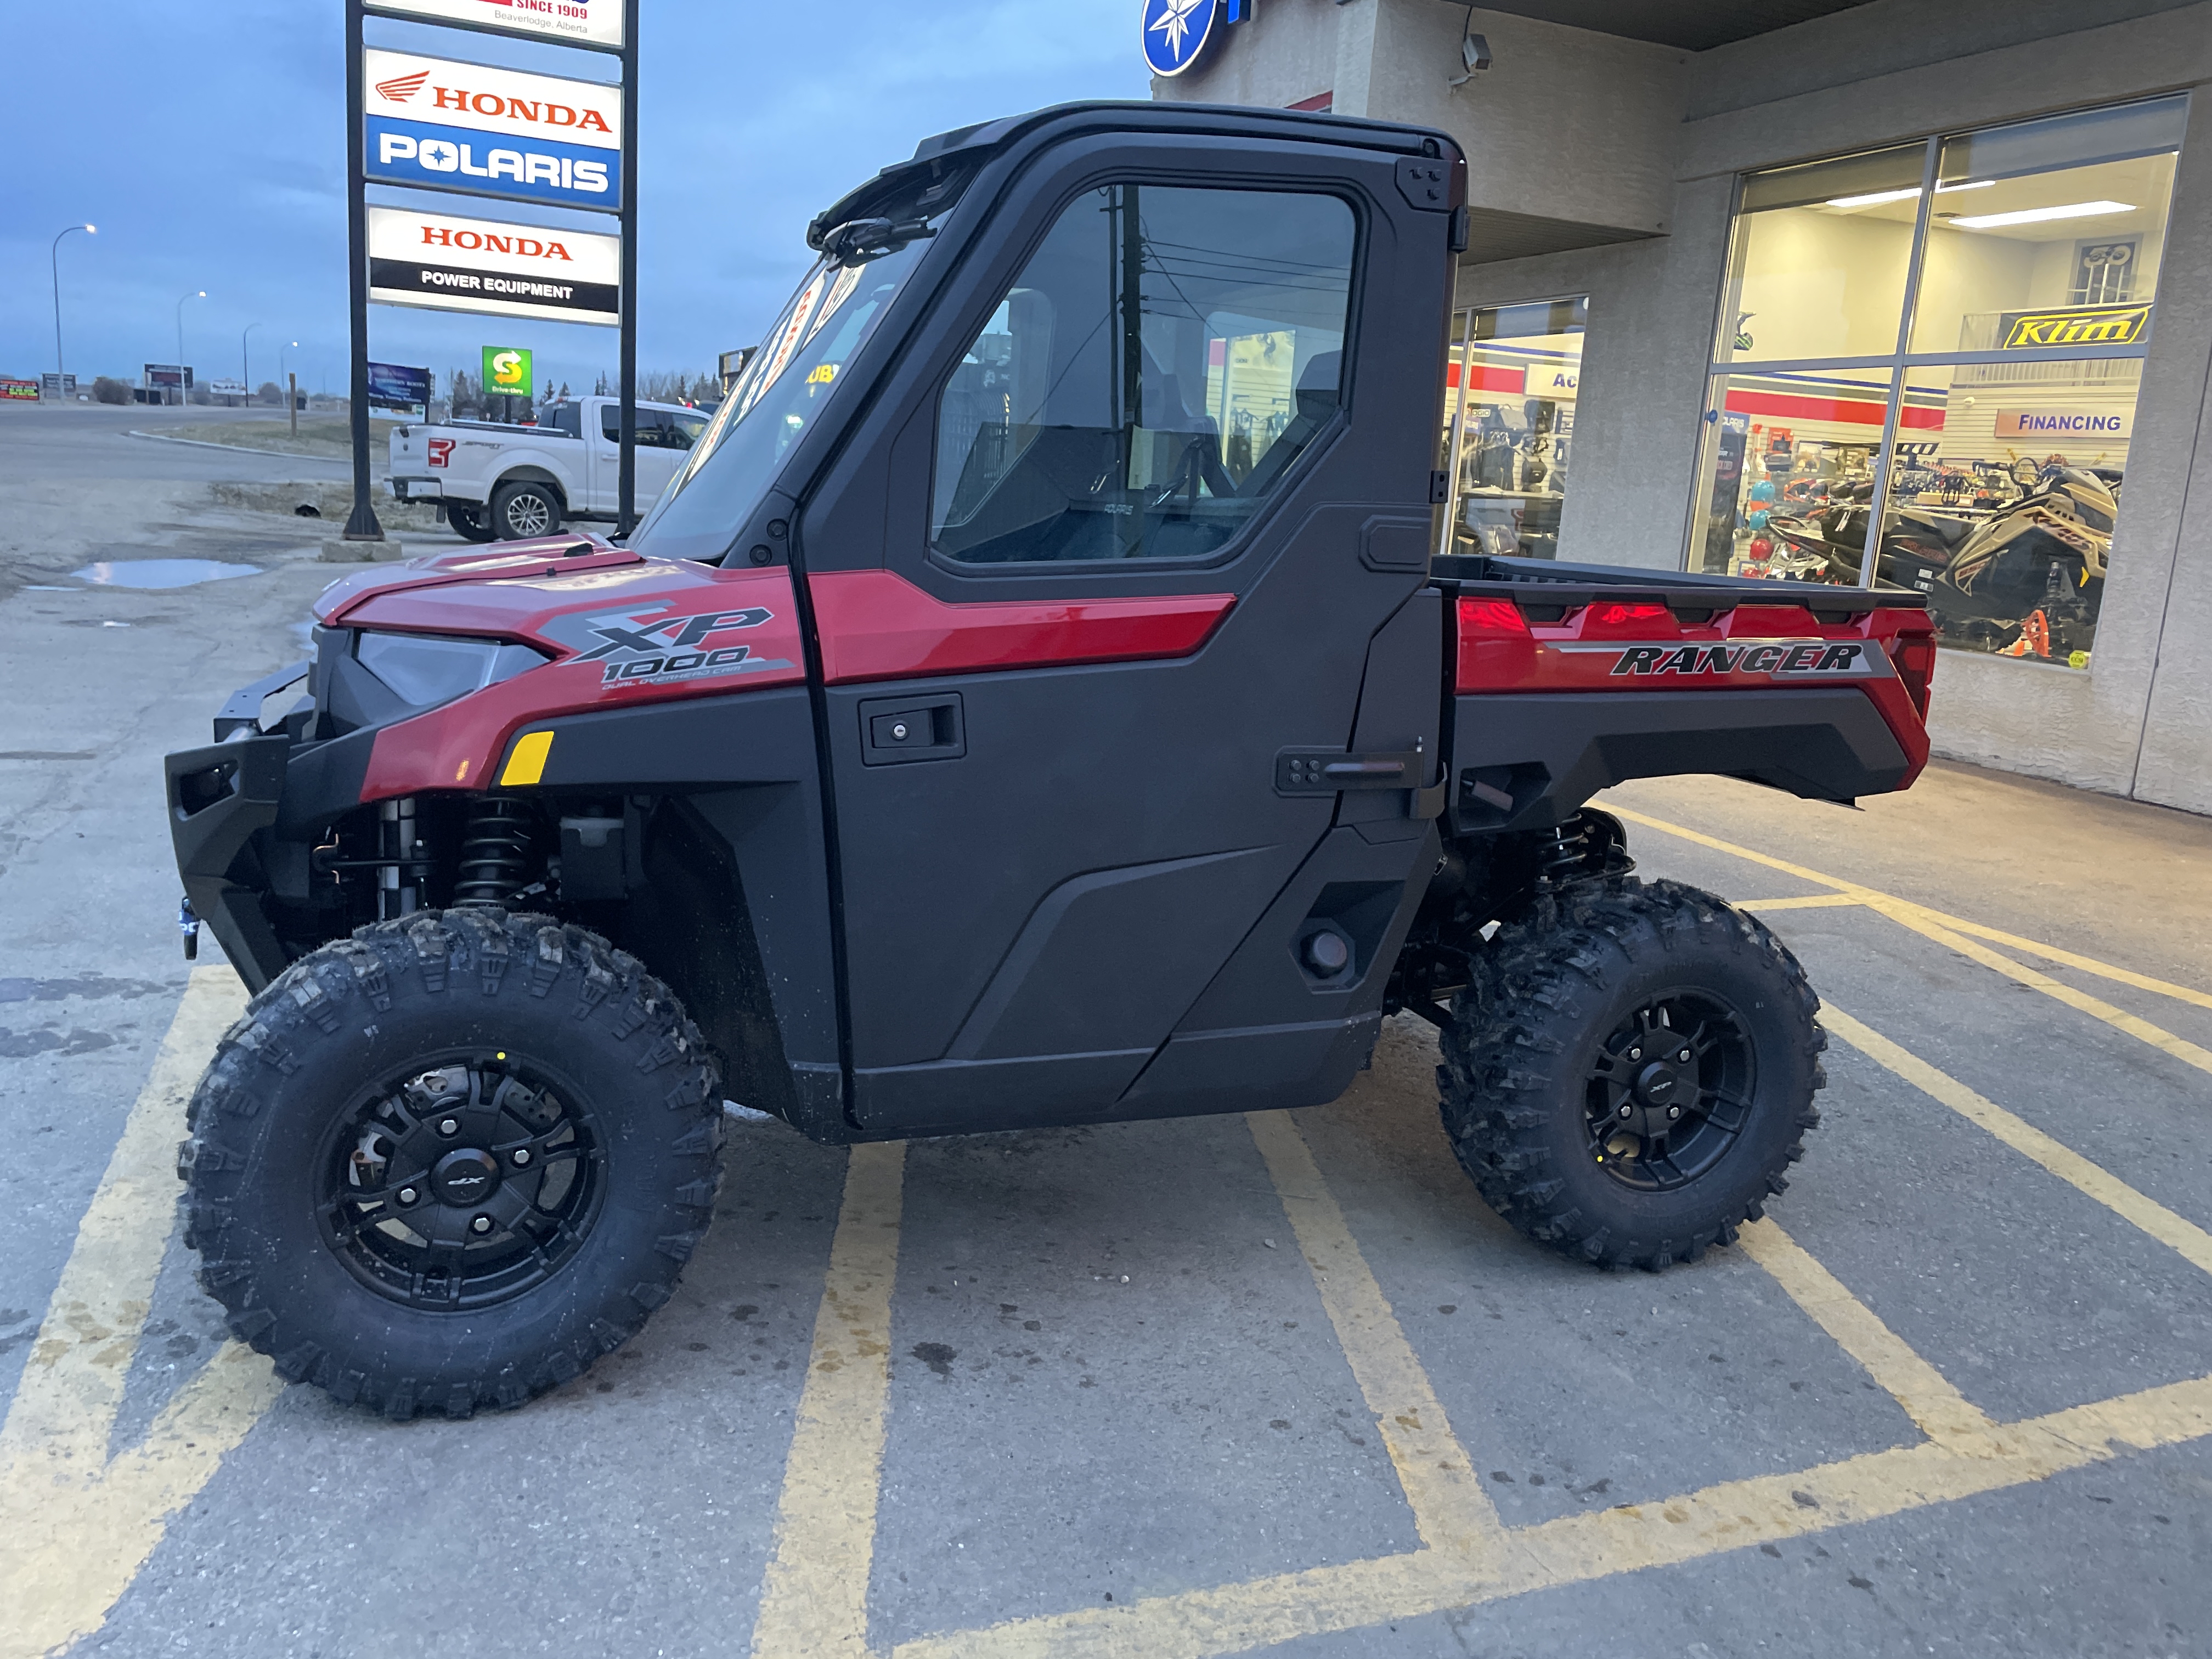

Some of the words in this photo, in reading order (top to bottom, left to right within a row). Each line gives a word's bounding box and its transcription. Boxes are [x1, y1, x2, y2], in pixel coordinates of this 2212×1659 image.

[495, 10, 554, 29] Beaverlodge,
[556, 20, 588, 33] Alberta
[517, 0, 553, 14] SINCE
[557, 4, 587, 19] 1909
[432, 86, 613, 133] HONDA
[379, 132, 609, 193] POLARIS
[420, 226, 574, 261] HONDA
[421, 270, 481, 290] POWER
[483, 278, 573, 300] EQUIPMENT
[2019, 414, 2121, 431] FINANCING
[557, 607, 775, 667] XP
[601, 646, 751, 682] 1000
[1610, 645, 1863, 676] RANGER
[602, 680, 636, 690] DUAL
[638, 669, 710, 685] OVERHEAD
[712, 665, 742, 675] CAM
